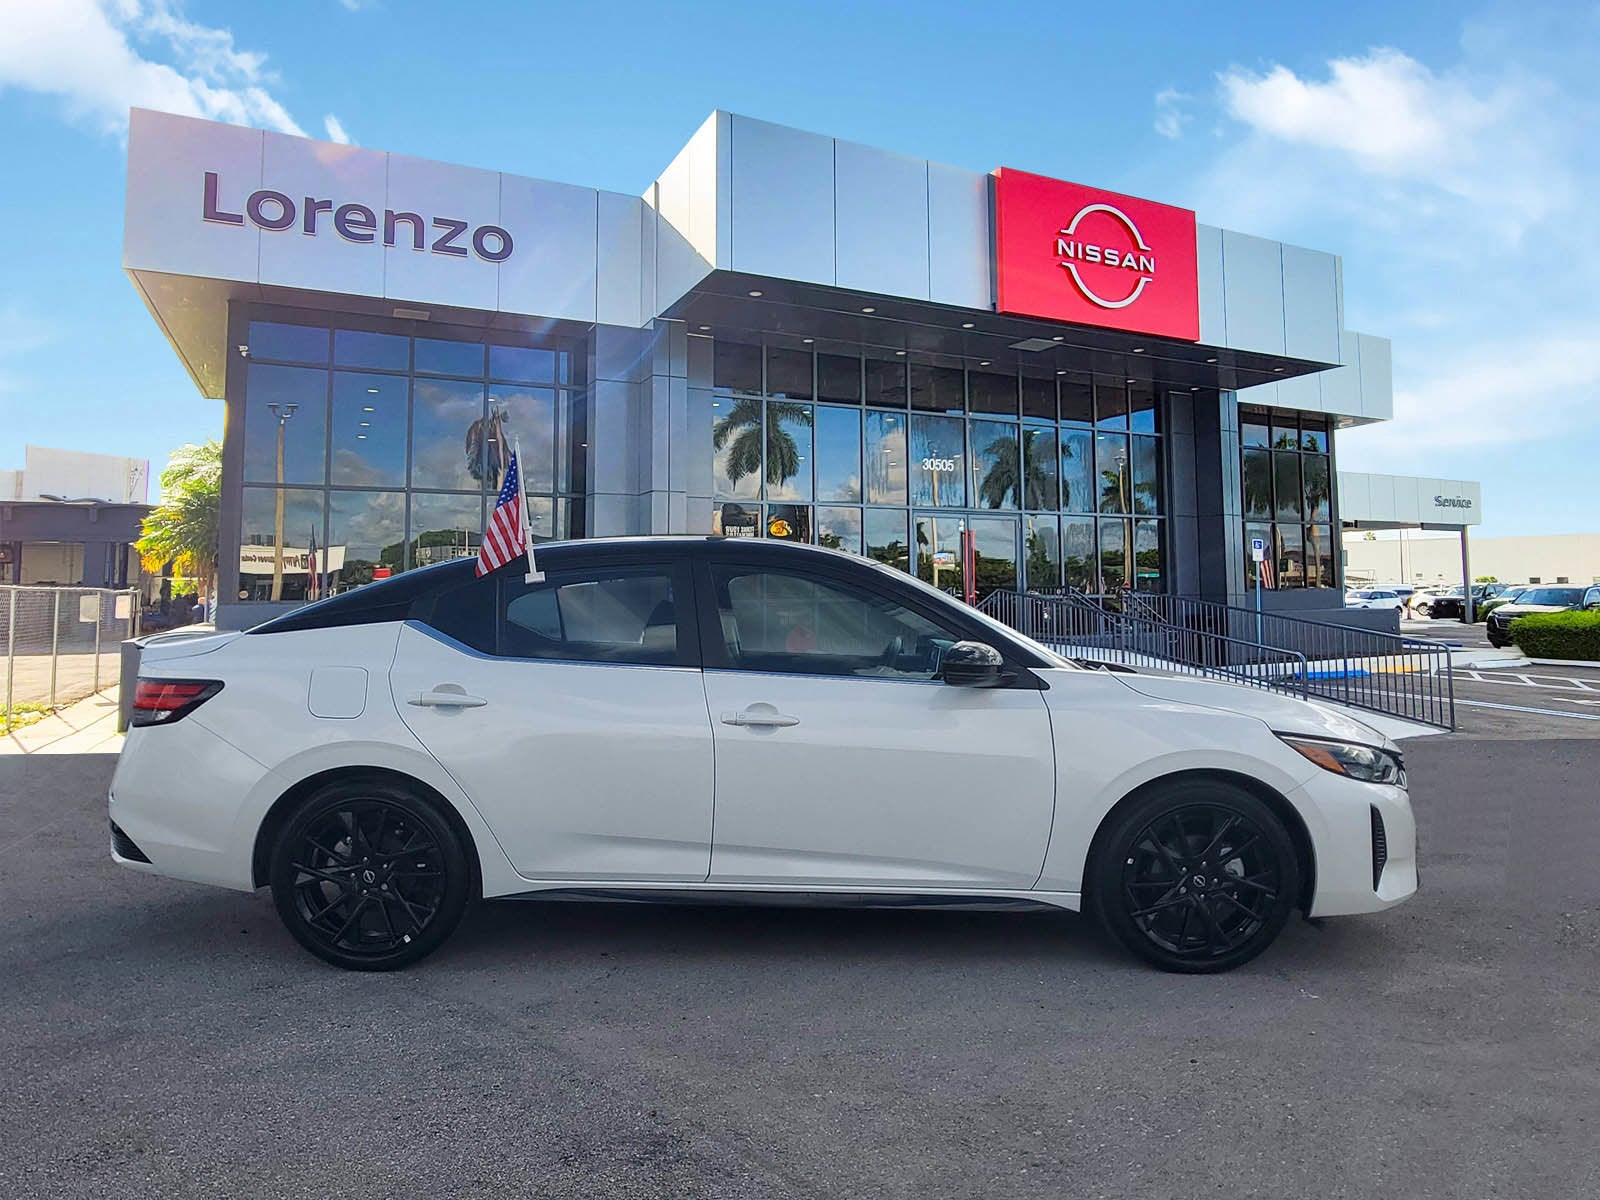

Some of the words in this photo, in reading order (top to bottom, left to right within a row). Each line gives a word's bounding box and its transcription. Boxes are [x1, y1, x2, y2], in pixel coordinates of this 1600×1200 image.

[202, 171, 514, 262] Lorenzo
[1058, 238, 1155, 273] NISSAN
[922, 457, 955, 472] 30505
[1433, 495, 1472, 509] Service
